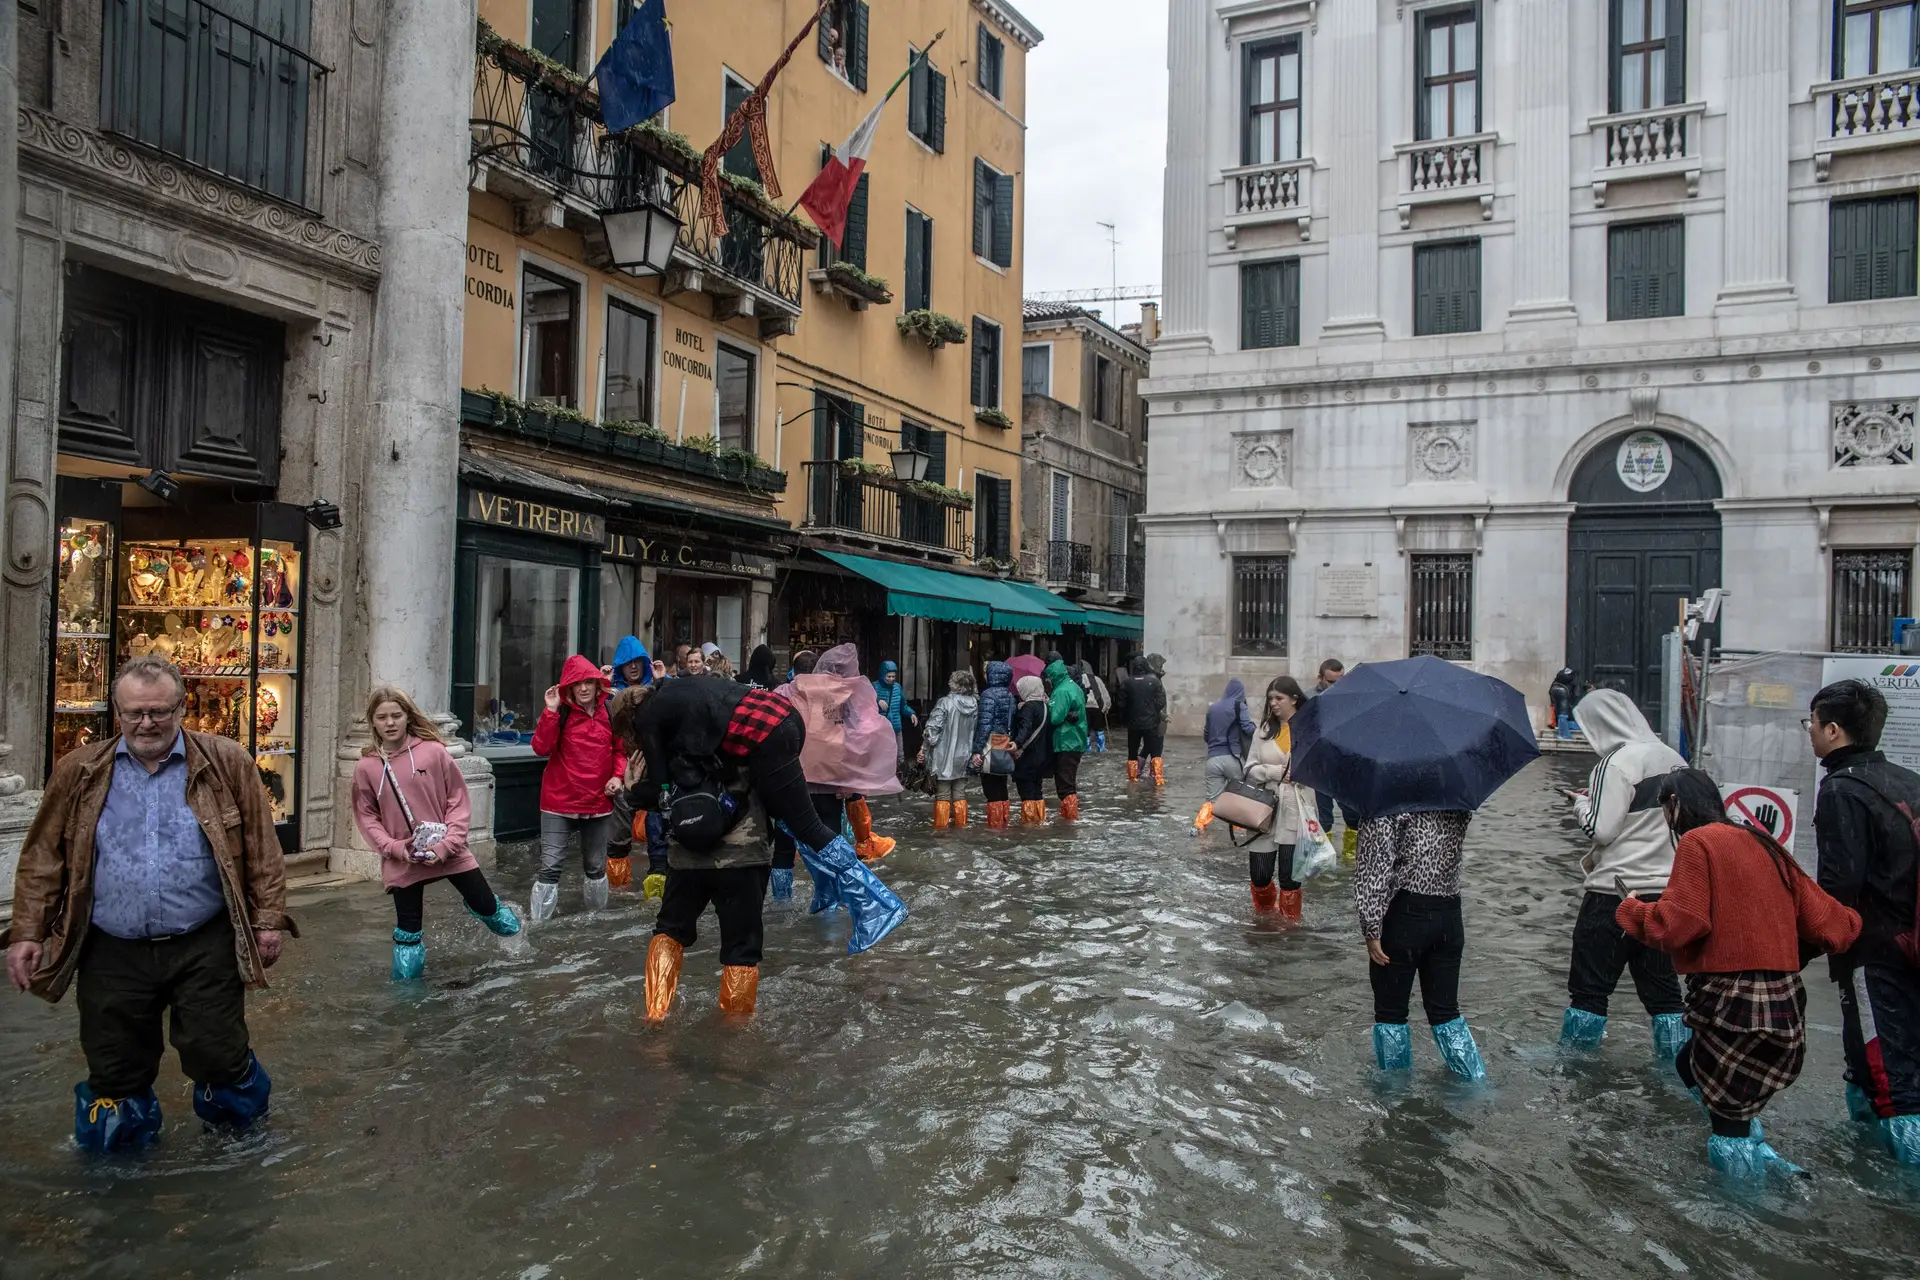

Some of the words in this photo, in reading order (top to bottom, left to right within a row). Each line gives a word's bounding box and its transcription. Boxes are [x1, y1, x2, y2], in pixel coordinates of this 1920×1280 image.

[466, 242, 504, 273] OTEL
[675, 327, 705, 353] HOTEL
[663, 350, 712, 381] CONCORDIA
[477, 492, 595, 537] VETRERIA
[660, 549, 670, 562] &
[678, 545, 696, 566] C.
